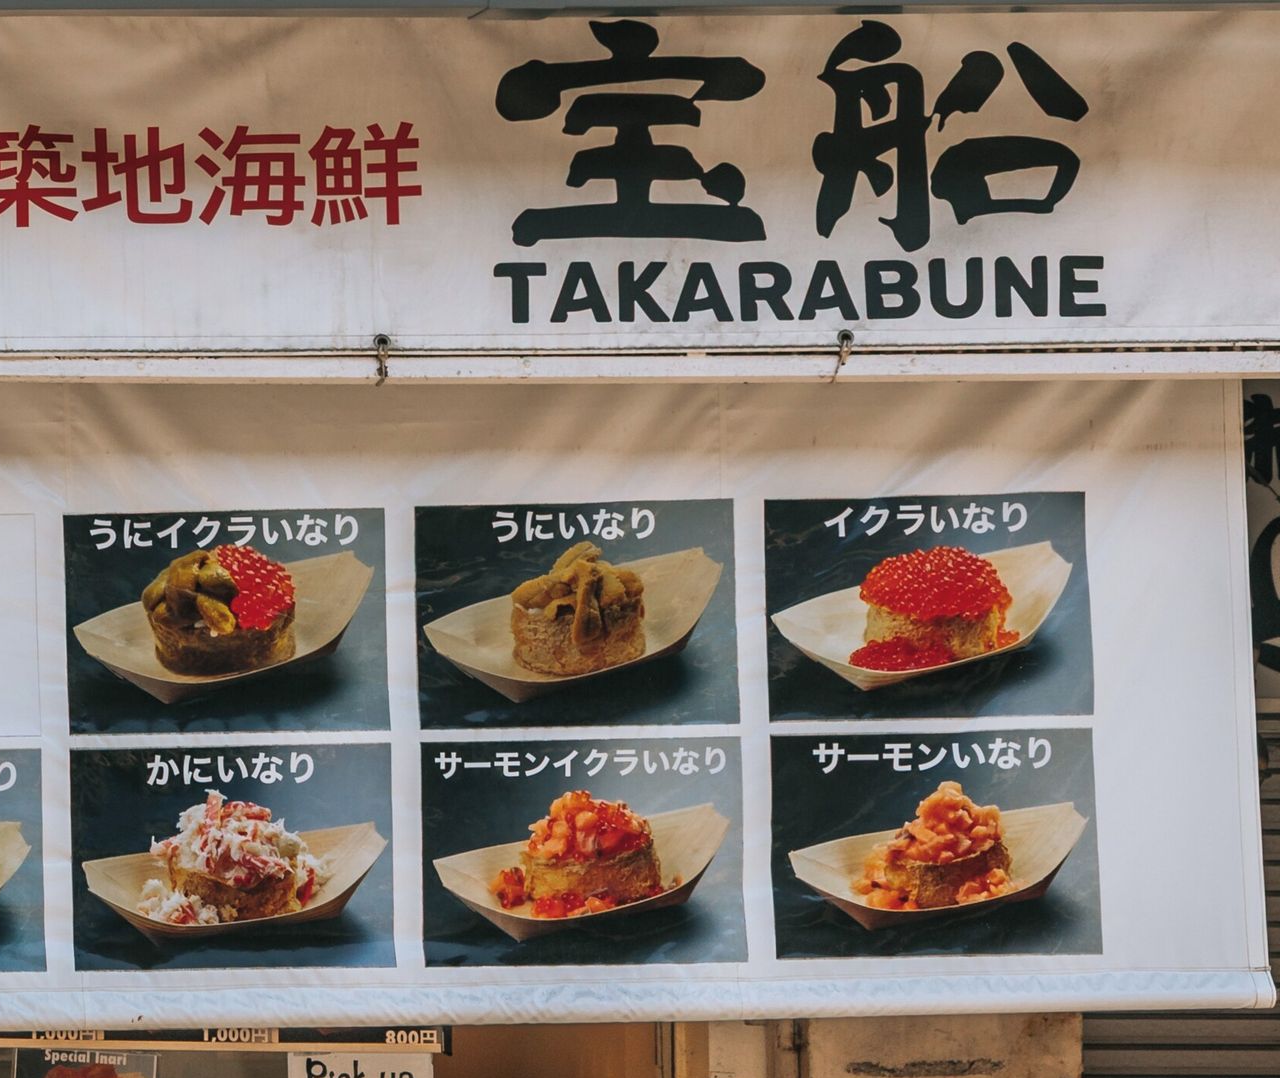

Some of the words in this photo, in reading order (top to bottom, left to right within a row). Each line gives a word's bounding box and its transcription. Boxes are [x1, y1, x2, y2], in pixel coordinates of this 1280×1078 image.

[495, 19, 1090, 250] 宝船
[493, 254, 1108, 324] TAKARABUNE
[89, 515, 360, 550] うにイクラいなり
[491, 509, 657, 543] うにいなり
[824, 501, 1028, 538] イクラいなり
[146, 751, 315, 787] かにいなり
[434, 746, 727, 779] サーモンイクラいなり
[812, 738, 1052, 773] サーモンいなり
[384, 1030, 438, 1045] 800円
[44, 1048, 90, 1064] Special
[95, 1051, 127, 1066] Inari
